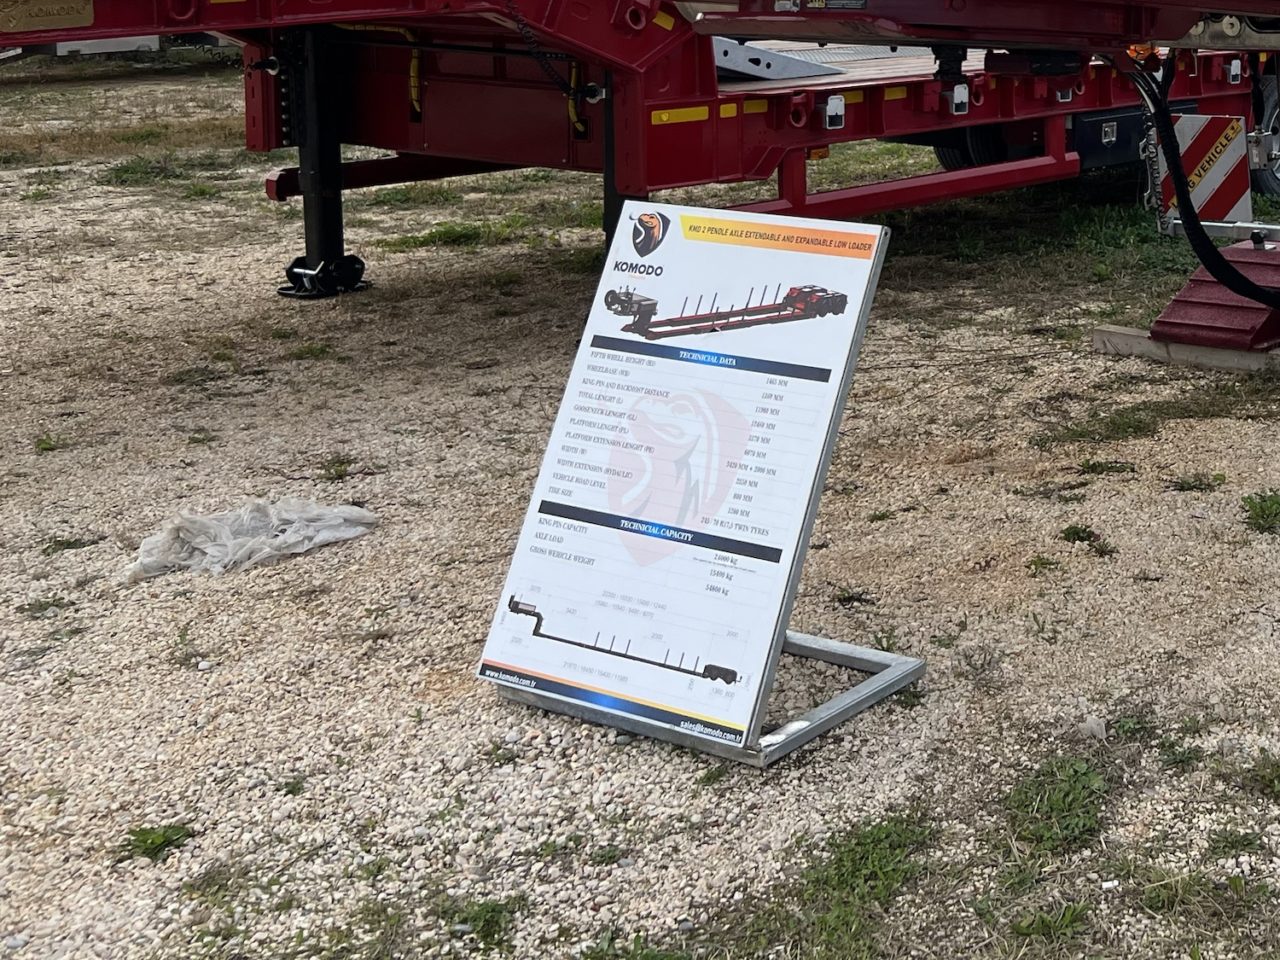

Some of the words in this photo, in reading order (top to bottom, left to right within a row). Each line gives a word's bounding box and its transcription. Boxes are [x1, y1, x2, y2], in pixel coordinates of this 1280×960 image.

[1196, 133, 1233, 179] VEHICLE
[728, 228, 744, 237] AXLE
[744, 230, 781, 241] EXTENDABLE
[781, 234, 795, 243] AND
[794, 235, 833, 247] EXPANDABLE
[833, 240, 848, 249] LOW
[847, 241, 872, 251] LOADER
[612, 260, 664, 276] KOMODO
[718, 356, 737, 366] DATA
[659, 527, 694, 542] CAPACITY
[484, 667, 537, 688] www.komodo.com.tr
[678, 719, 742, 744] sales@komodo.com.tr
